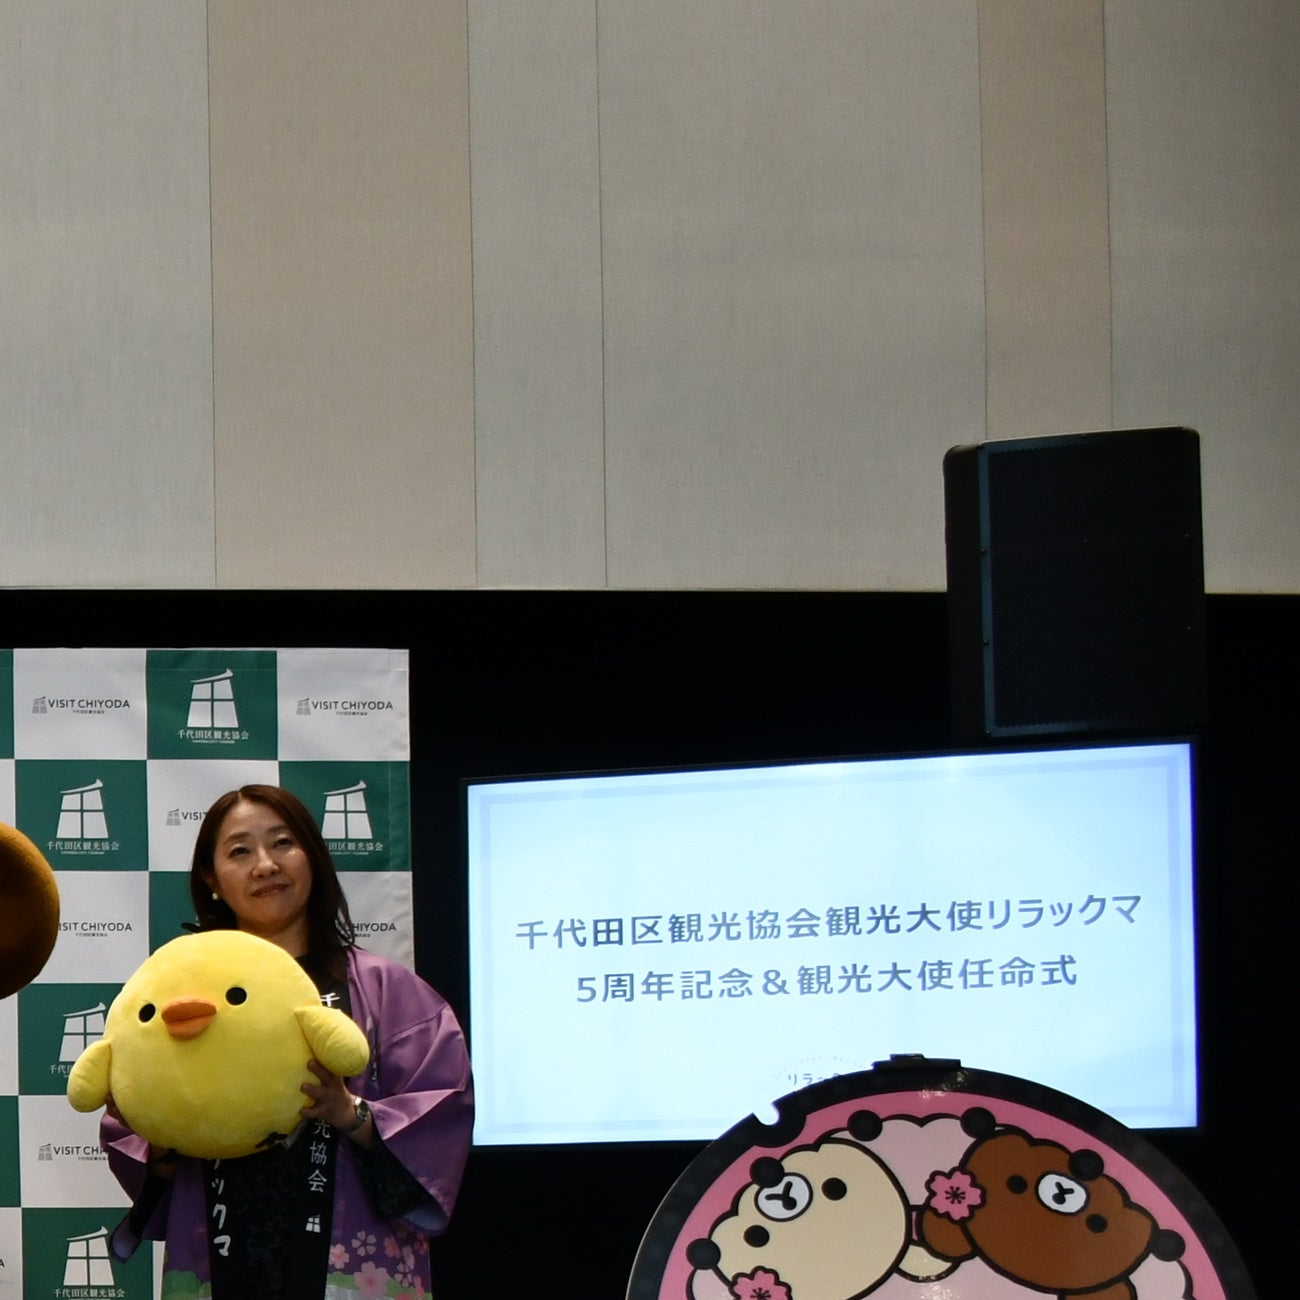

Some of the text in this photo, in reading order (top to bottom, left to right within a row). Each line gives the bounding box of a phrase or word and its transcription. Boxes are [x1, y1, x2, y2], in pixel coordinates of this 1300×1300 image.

[48, 699, 130, 709] VISIT CHIYODA
[311, 700, 393, 711] VISIT CHIYODA
[328, 841, 383, 852] 田区観光協会
[516, 893, 1143, 950] 千代田区観光協会観光大使リラックマ
[58, 922, 132, 932] ISIT CHIYODA
[350, 922, 397, 932] HIYODA
[576, 954, 1078, 1003] 5周年記念＆観光大使任命式
[53, 1145, 81, 1155] VISIT
